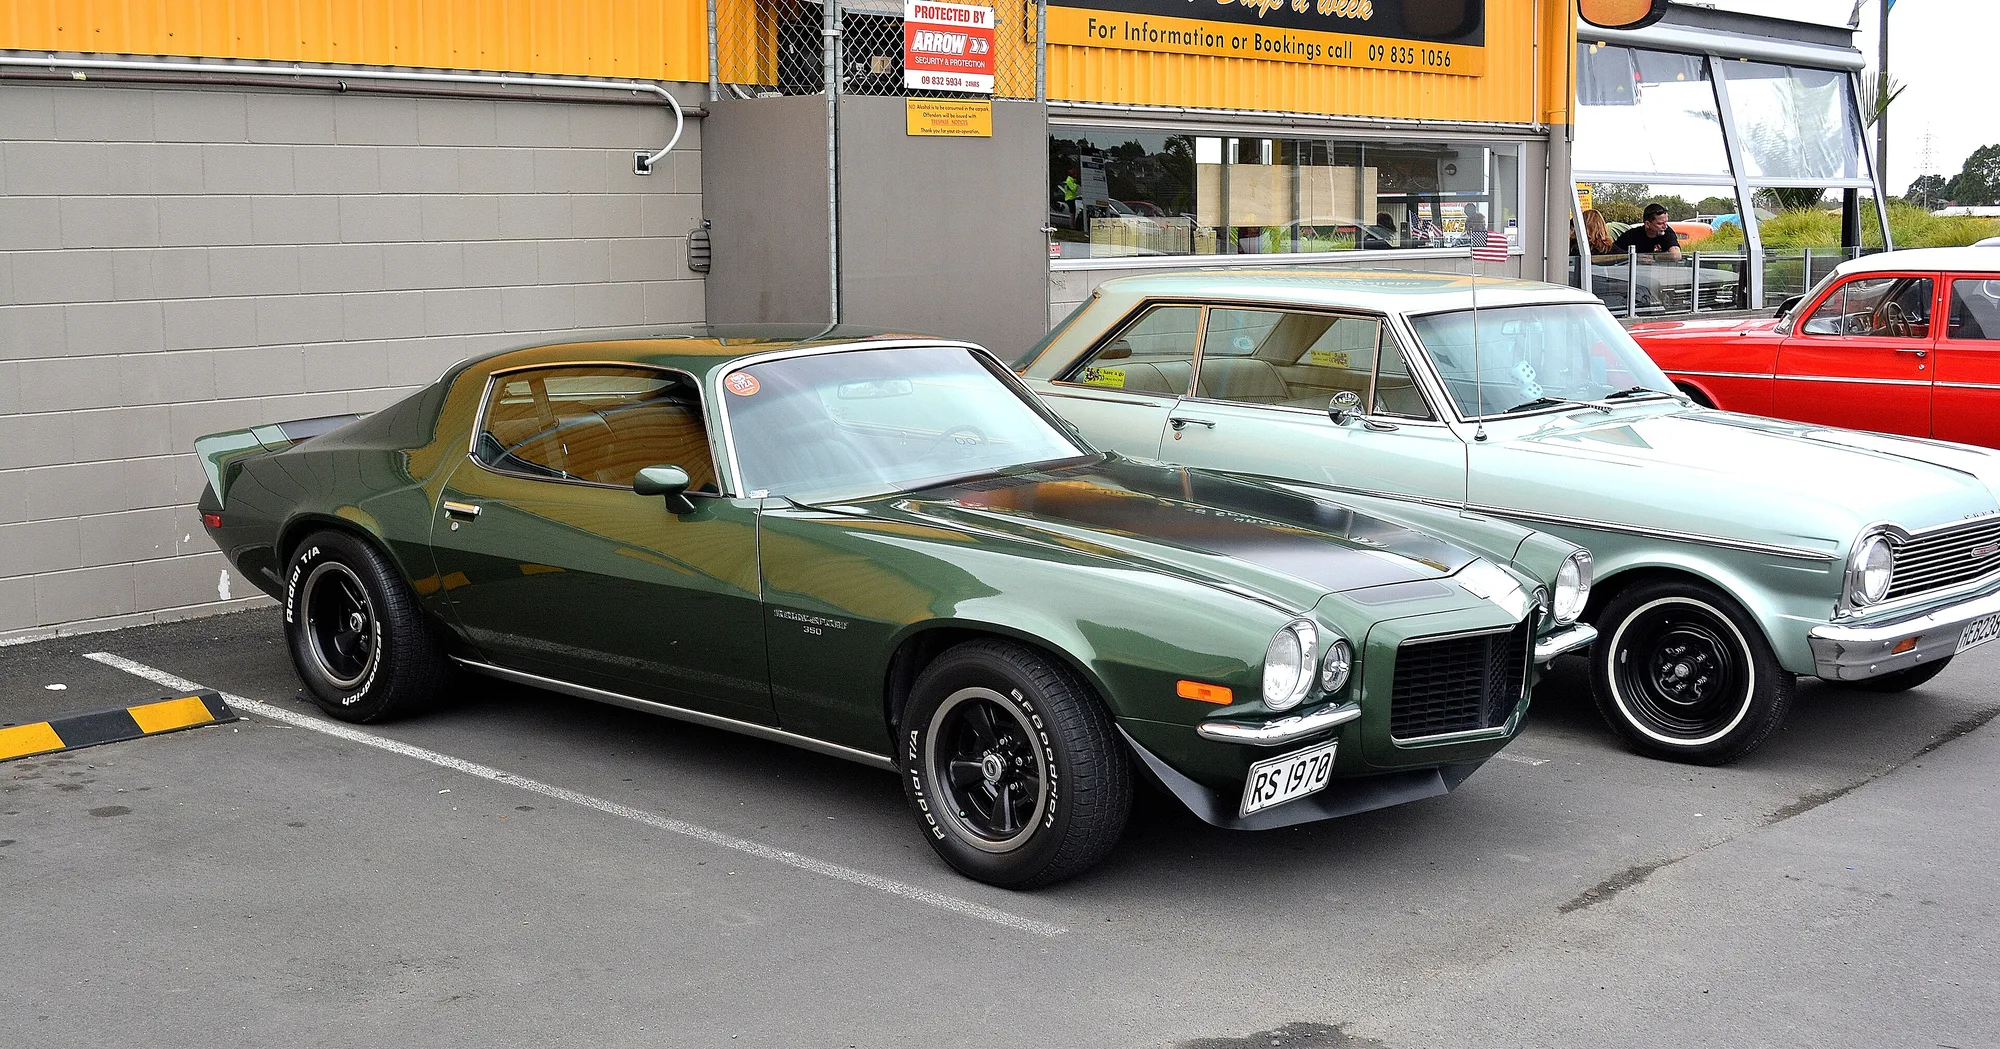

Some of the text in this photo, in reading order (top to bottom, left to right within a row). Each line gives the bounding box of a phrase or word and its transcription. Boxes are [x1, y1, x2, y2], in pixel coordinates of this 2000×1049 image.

[914, 5, 985, 24] PROTECTED BY
[1317, 0, 1373, 21] week
[910, 29, 968, 57] ARROW
[915, 56, 944, 66] SECURITY
[950, 59, 985, 68] PROTECTION
[1088, 18, 1451, 68] For Information or Bookings call 09 835 1056
[921, 76, 930, 85] 09
[931, 76, 945, 86] 832
[945, 77, 962, 86] 5934
[286, 546, 320, 624] Radial T/A
[803, 625, 822, 636] 350
[342, 620, 382, 707] BFGoodrich
[1010, 688, 1059, 829] BFGoodrich
[909, 730, 946, 840] Radial T/A
[1250, 752, 1331, 806] RS 1970
